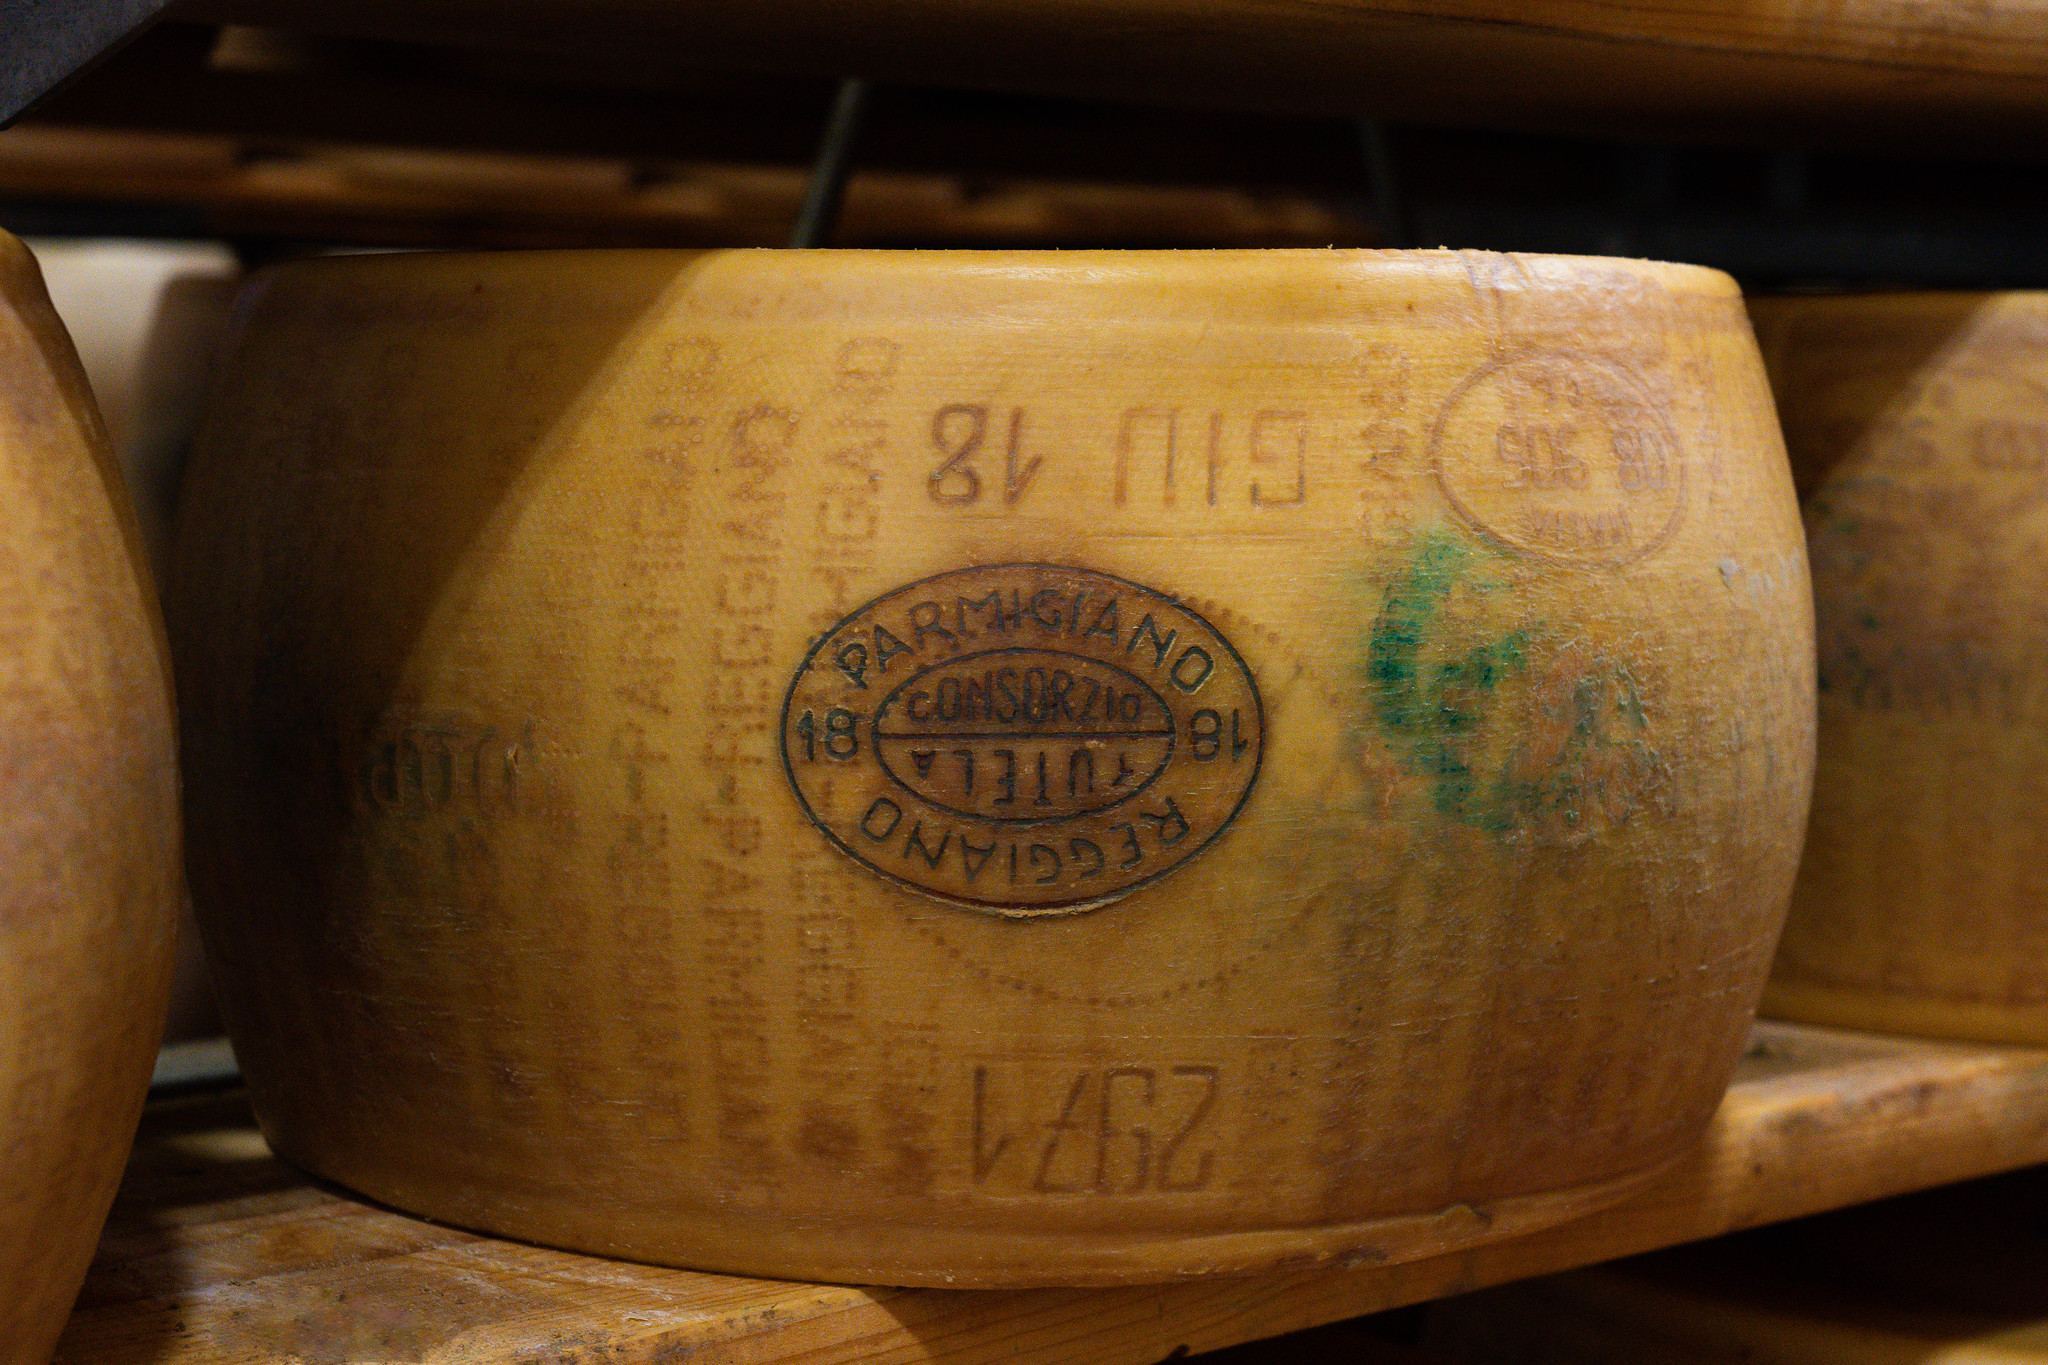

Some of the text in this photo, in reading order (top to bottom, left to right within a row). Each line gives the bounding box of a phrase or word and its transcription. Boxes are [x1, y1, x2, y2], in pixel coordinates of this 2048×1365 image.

[926, 403, 1045, 512] 18
[1112, 406, 1308, 510] GIU
[835, 588, 1214, 694] PARMIGIANO
[800, 708, 859, 763] 18
[906, 666, 1144, 726] CONSORZIO
[1190, 708, 1249, 763] 18
[911, 749, 1135, 806] TUTELA
[860, 797, 1191, 885] REGGIANO
[972, 1065, 1221, 1195] 2971
